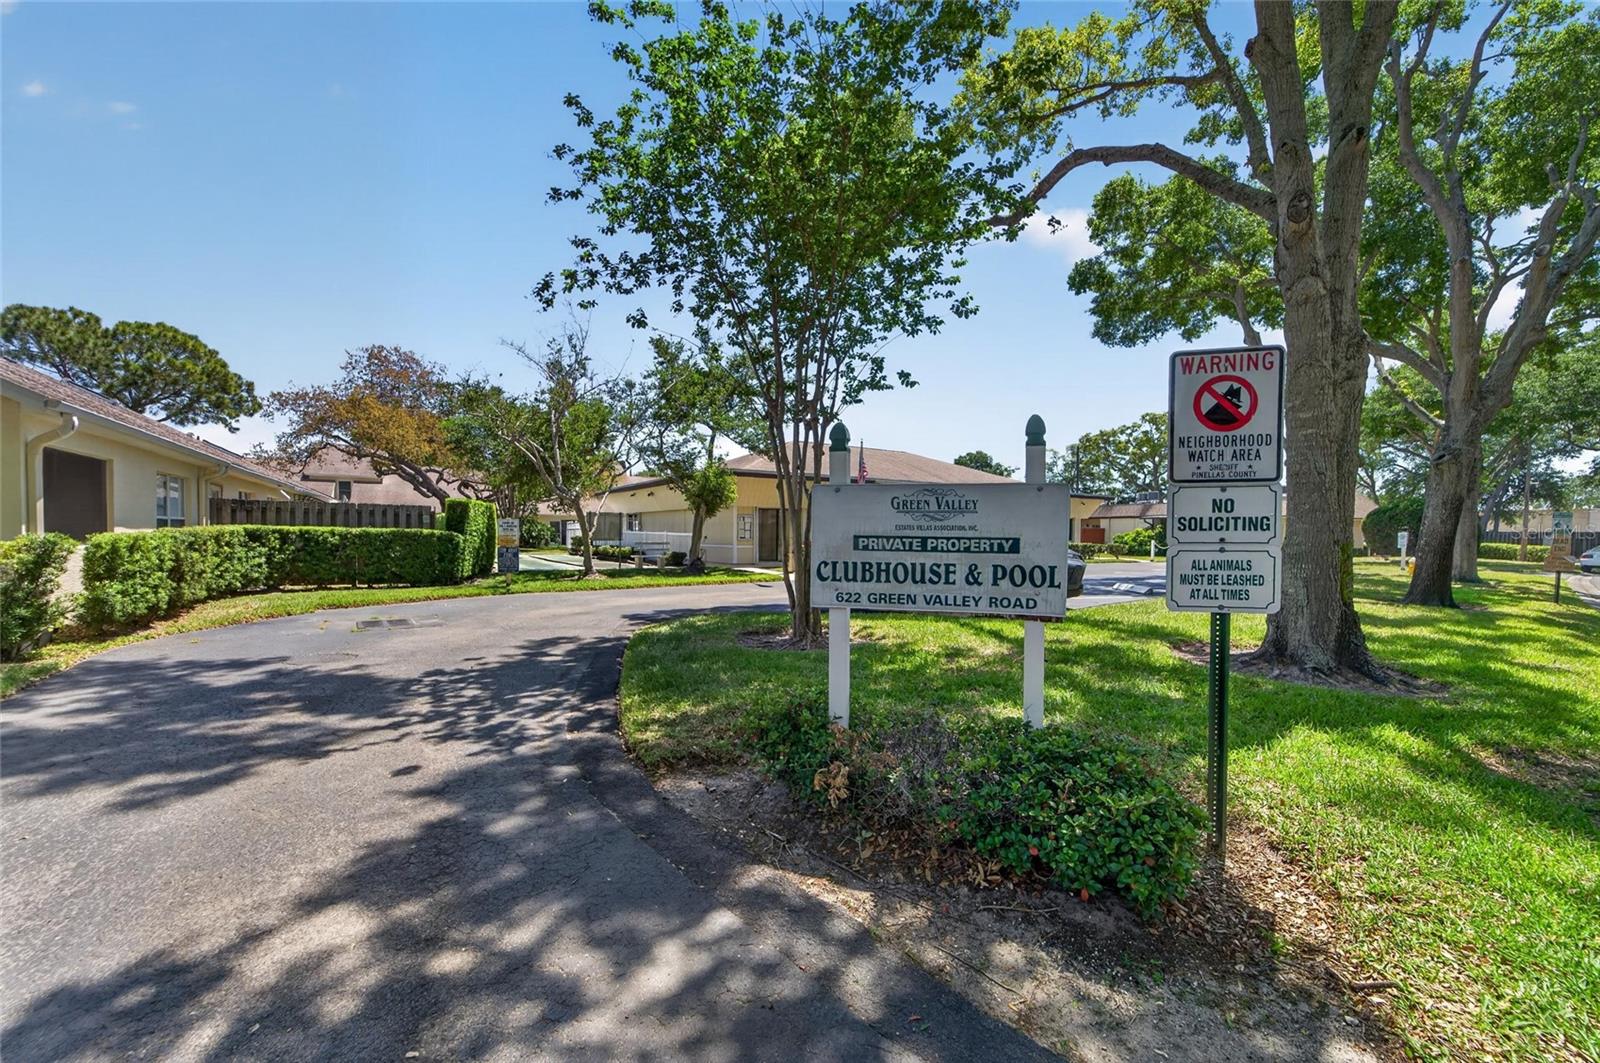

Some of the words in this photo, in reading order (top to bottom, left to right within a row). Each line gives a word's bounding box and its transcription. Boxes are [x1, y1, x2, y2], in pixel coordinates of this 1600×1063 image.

[1180, 352, 1274, 375] WARNING
[1179, 433, 1272, 448] NEIGHBORHOOD
[1188, 449, 1224, 462] WATCH
[1232, 449, 1262, 462] AREA
[1228, 470, 1257, 478] COUNTY
[1212, 498, 1235, 513] NO
[1178, 516, 1271, 532] SOLICITING
[858, 538, 922, 551] PRIVATE
[927, 538, 1013, 552] PROPERTY
[1191, 560, 1208, 570] ALL
[1210, 560, 1252, 571] ANIMALS
[816, 561, 956, 586] CLUBHOUSE
[964, 564, 984, 586] &
[991, 564, 1062, 590] POOL
[1180, 574, 1207, 586] MUST
[1208, 574, 1220, 586] BE
[1222, 574, 1264, 586] LEASHED
[835, 592, 861, 604] 622
[867, 592, 917, 605] GREEN
[922, 594, 982, 608] VALLEY
[988, 596, 1038, 610] ROAD
[1190, 589, 1202, 600] AT
[1202, 589, 1219, 600] ALL
[1221, 590, 1250, 600] TIMES
